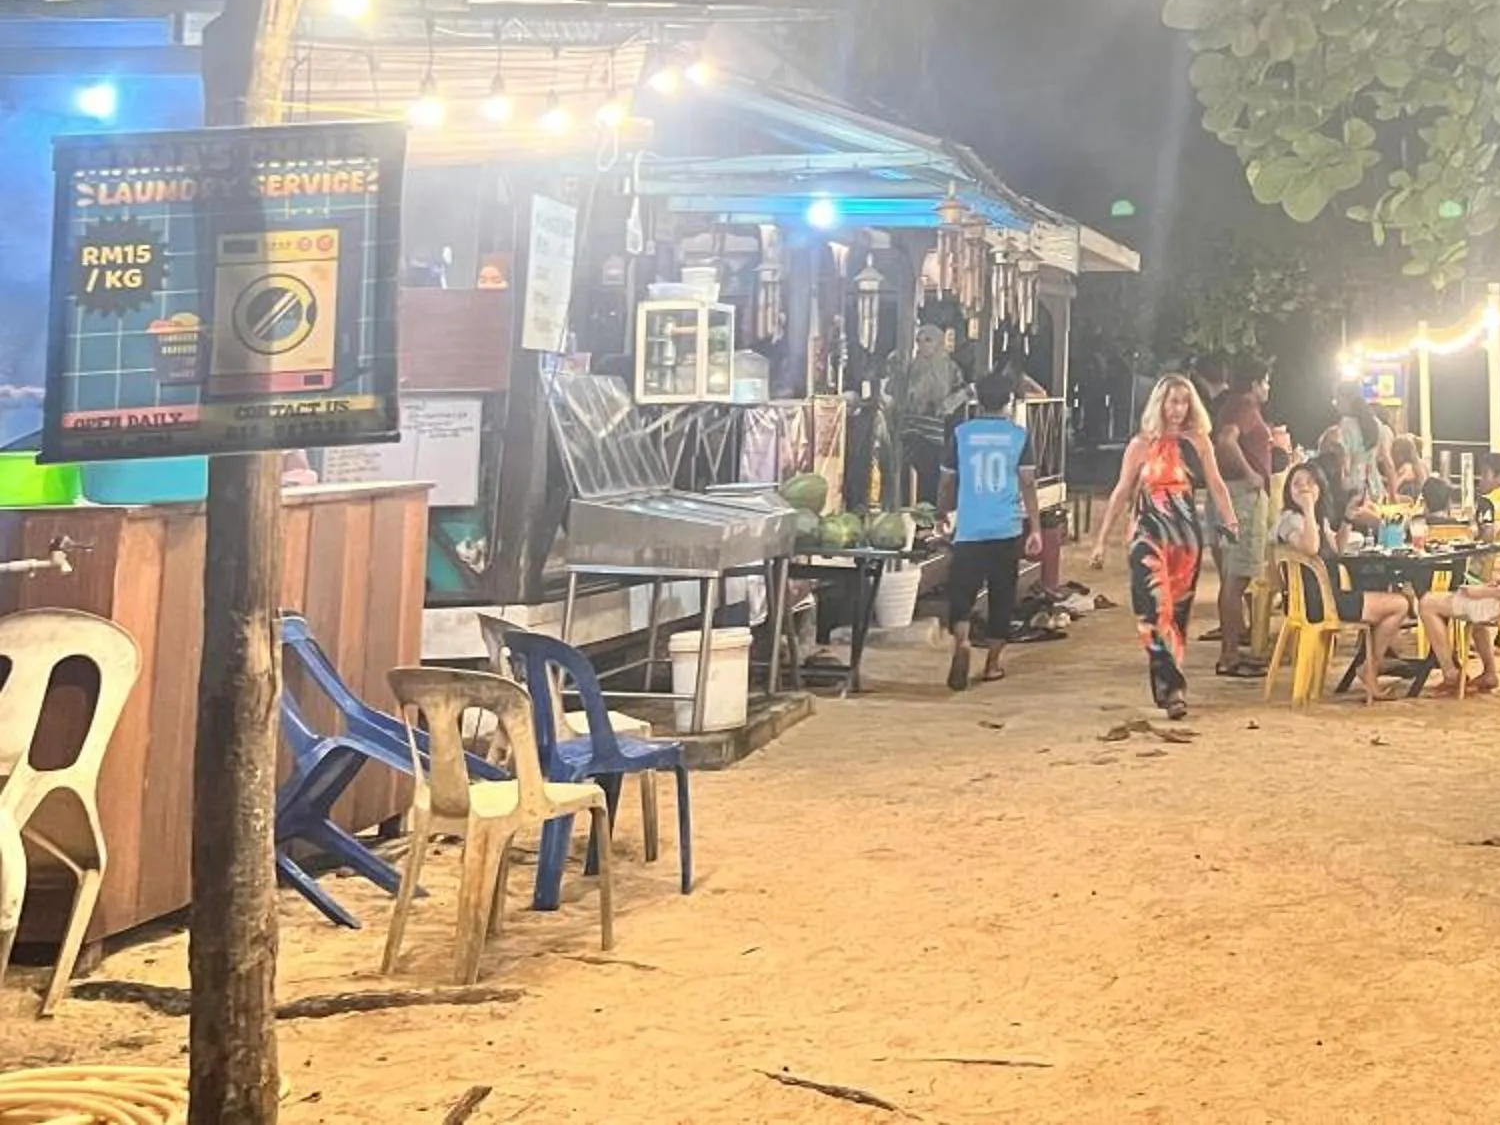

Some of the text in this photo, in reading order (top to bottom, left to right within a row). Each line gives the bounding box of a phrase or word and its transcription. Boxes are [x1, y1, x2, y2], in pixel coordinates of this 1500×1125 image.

[97, 171, 366, 206] LAUNDRY SERVICE
[81, 243, 152, 266] RM15
[233, 400, 350, 420] CONTACT US
[73, 412, 183, 432] OPEN DAILY
[970, 451, 1009, 494] 10
